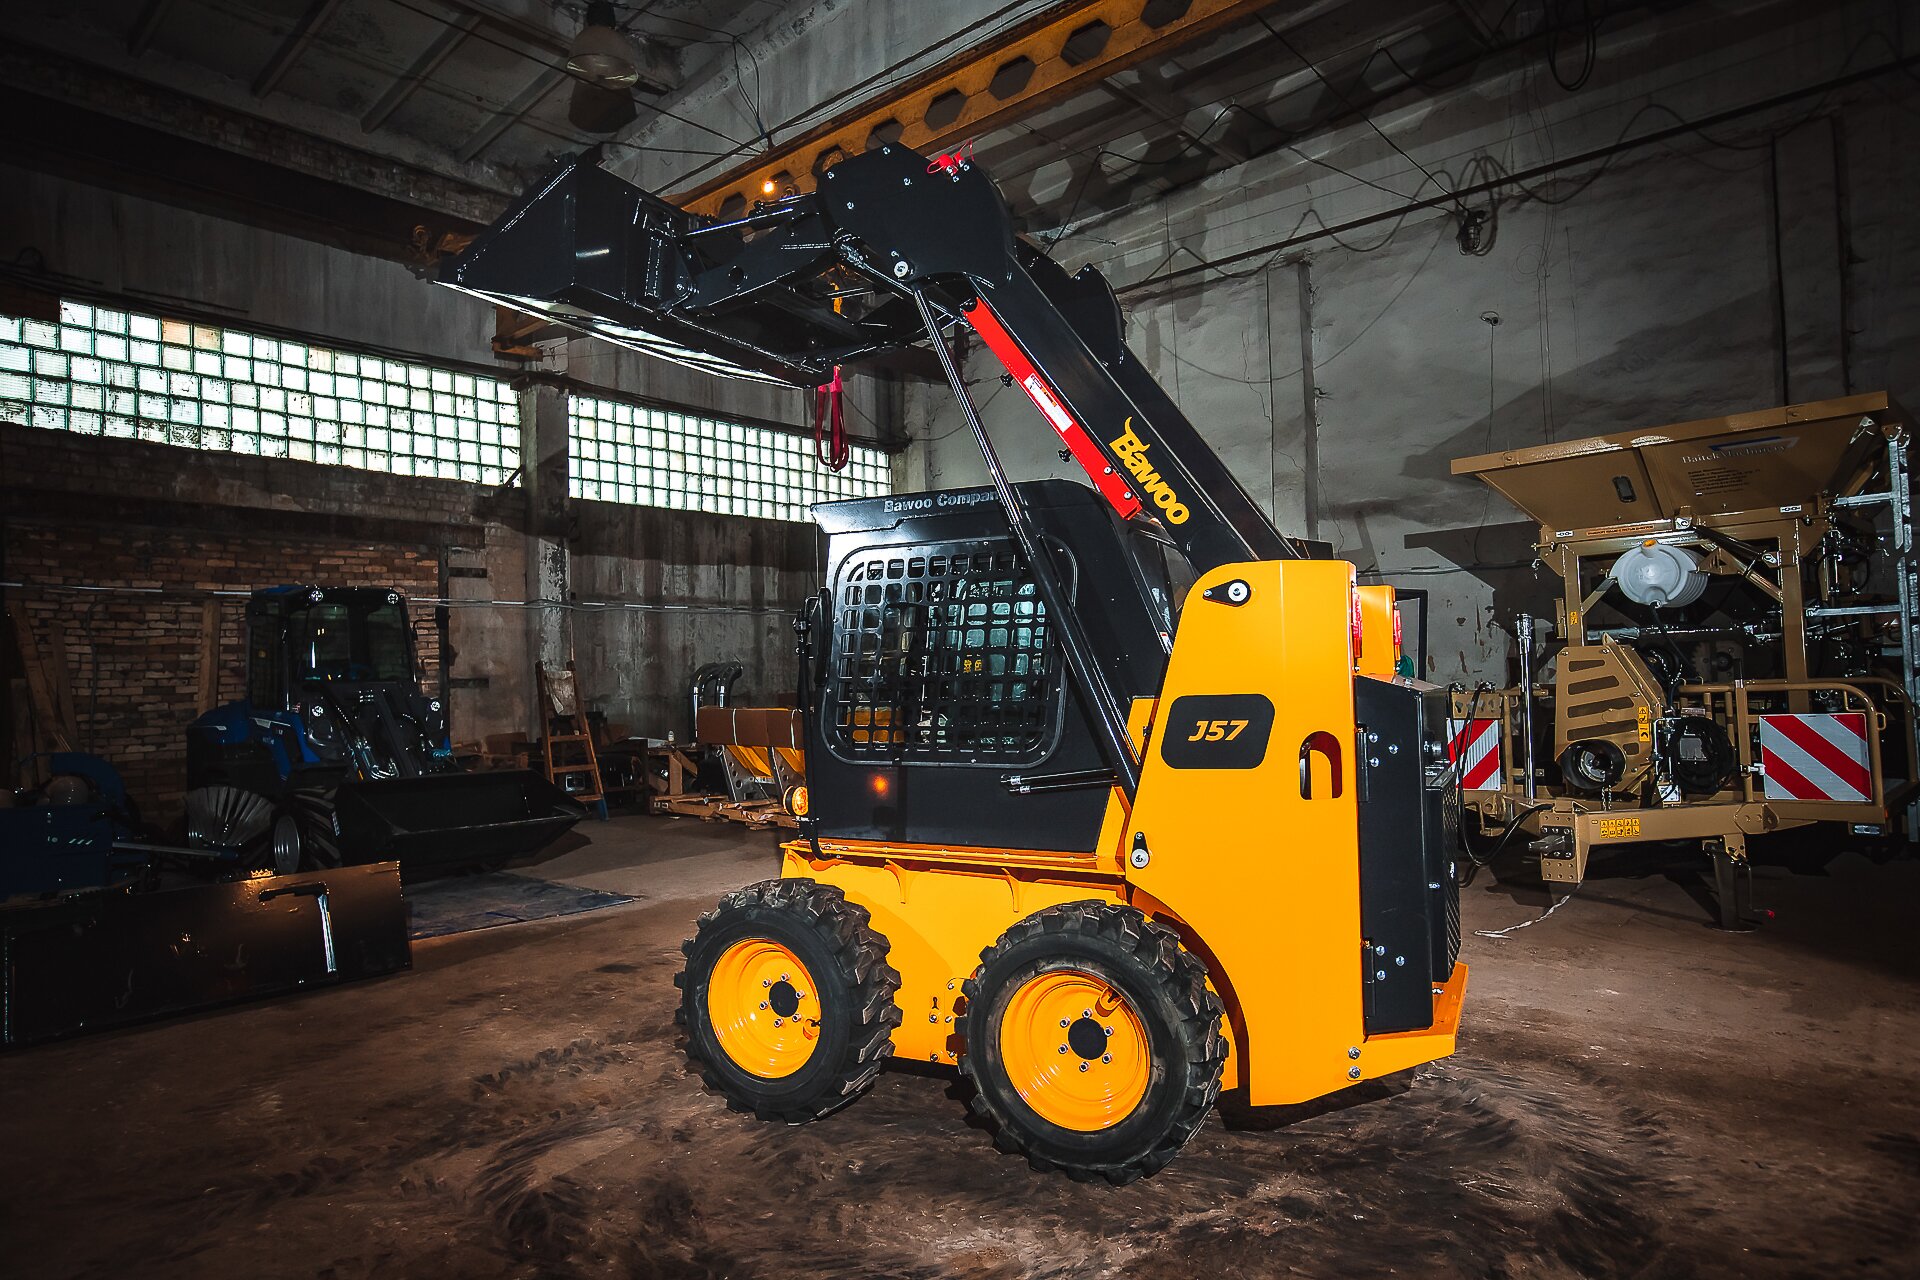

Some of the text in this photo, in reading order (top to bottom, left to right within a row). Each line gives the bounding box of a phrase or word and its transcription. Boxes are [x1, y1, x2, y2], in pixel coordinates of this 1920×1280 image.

[1109, 416, 1190, 525] Bawoo
[883, 490, 999, 513] Bawoo Compan
[1187, 719, 1249, 742] J57
